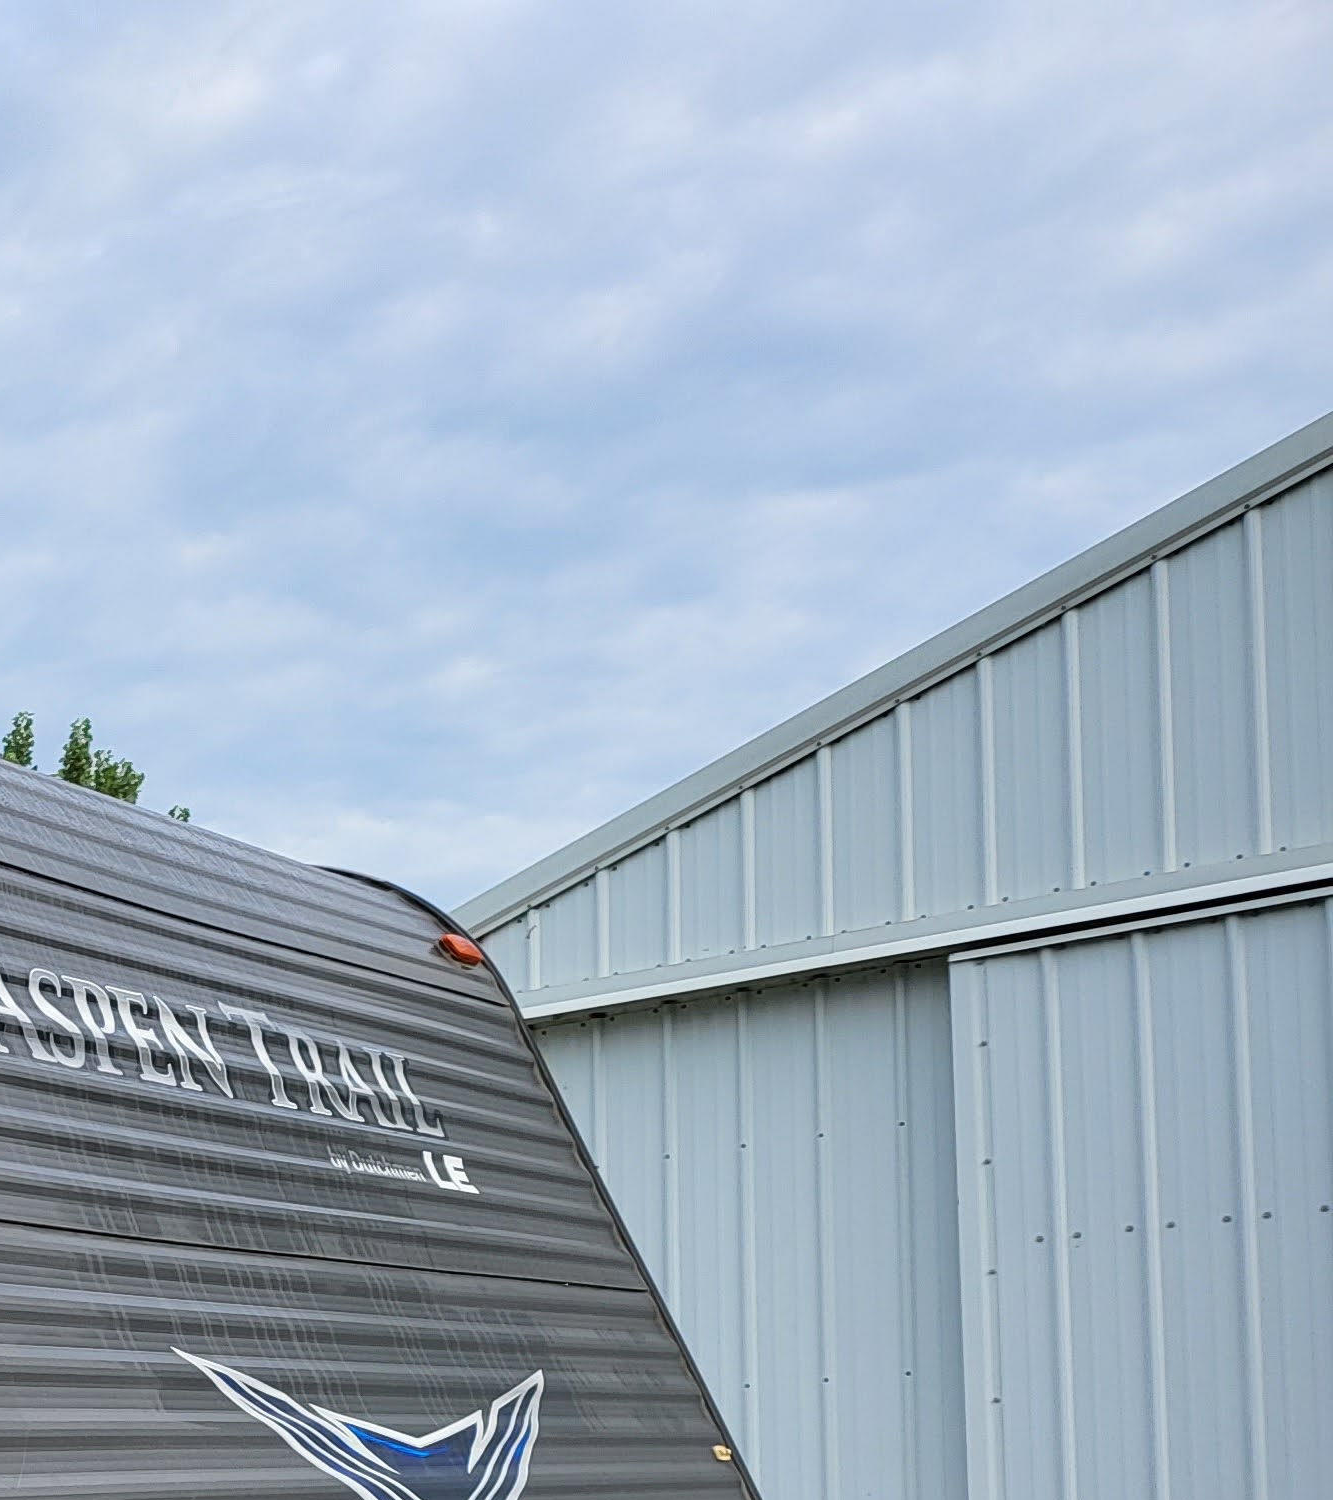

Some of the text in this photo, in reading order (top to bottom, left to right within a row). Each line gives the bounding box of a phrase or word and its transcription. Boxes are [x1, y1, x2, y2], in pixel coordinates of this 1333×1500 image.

[218, 1001, 446, 1138] TRAIL
[348, 1150, 428, 1183] Dutchmen
[422, 1150, 481, 1195] LE
